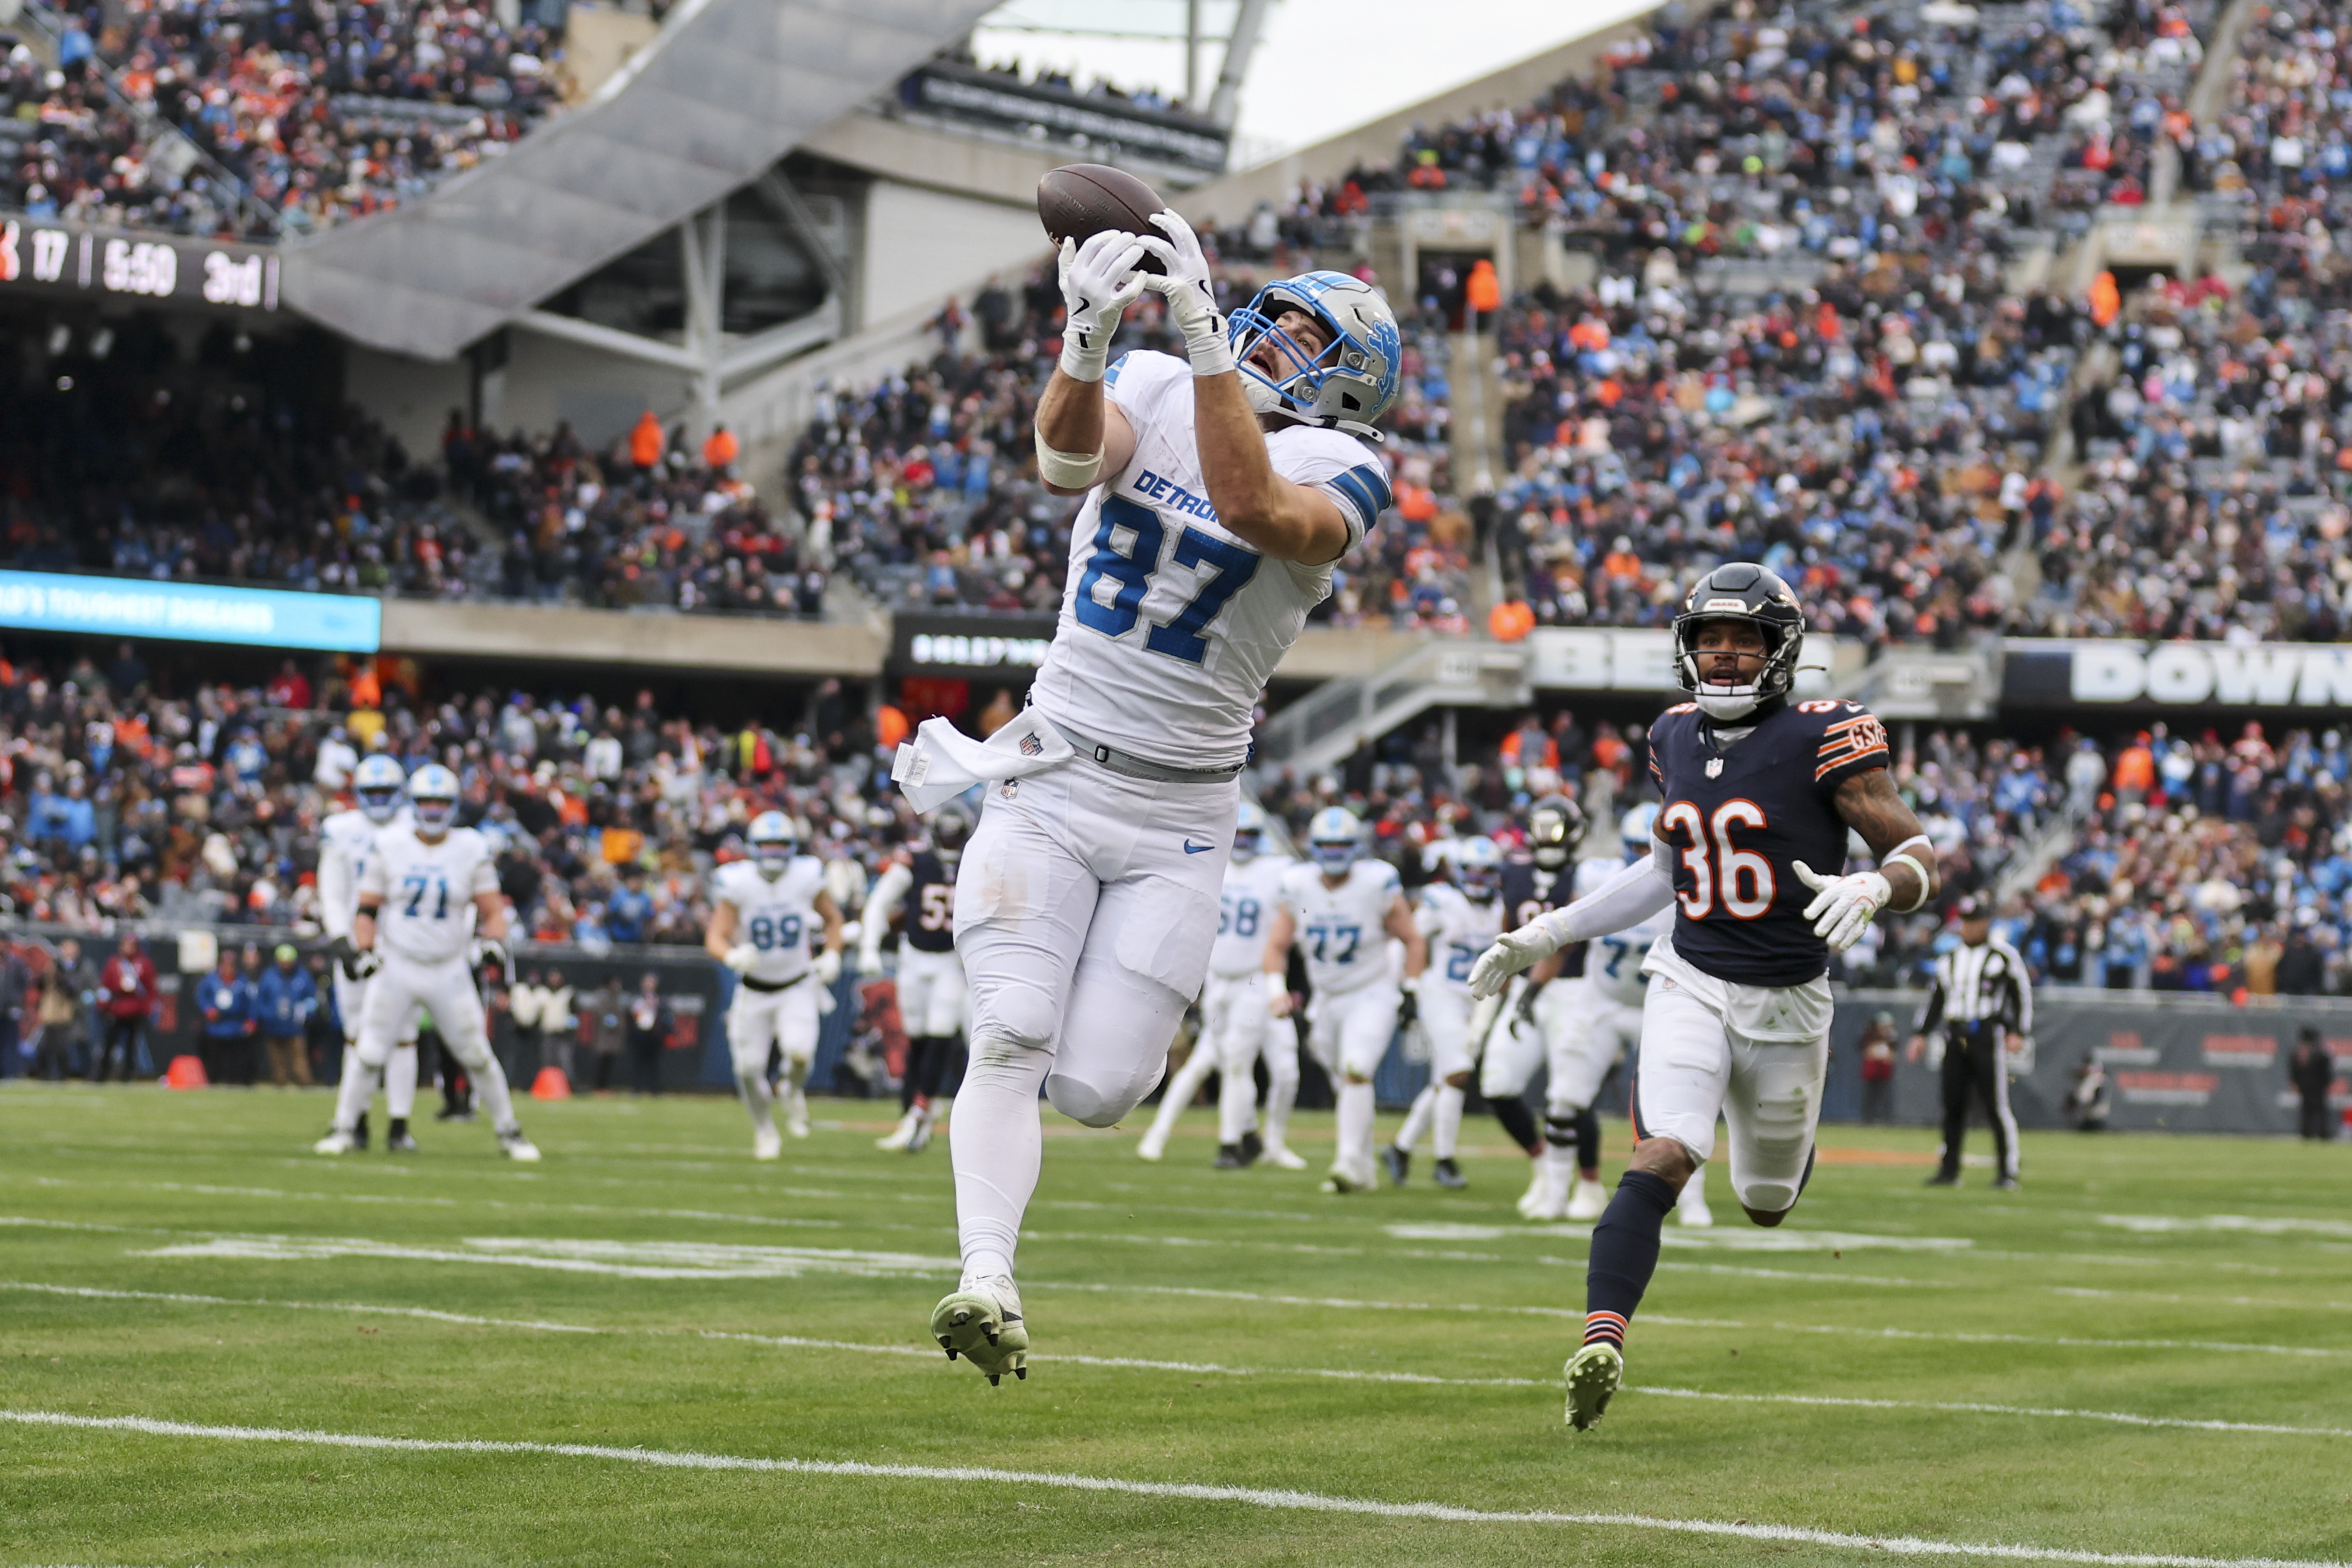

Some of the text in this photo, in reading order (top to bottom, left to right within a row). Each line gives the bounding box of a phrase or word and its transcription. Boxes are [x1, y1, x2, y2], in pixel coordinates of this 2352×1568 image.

[31, 228, 262, 307] 17 5:50 3rd
[1132, 468, 1219, 523] DETRO
[1073, 492, 1263, 670] 87
[2069, 645, 2352, 706] DOWN
[1848, 721, 1884, 750] GSH
[1002, 785, 1015, 796] NFL
[1663, 797, 1777, 921] 36
[403, 875, 448, 919] 71
[750, 913, 802, 951] 89
[1306, 924, 1361, 964] 77
